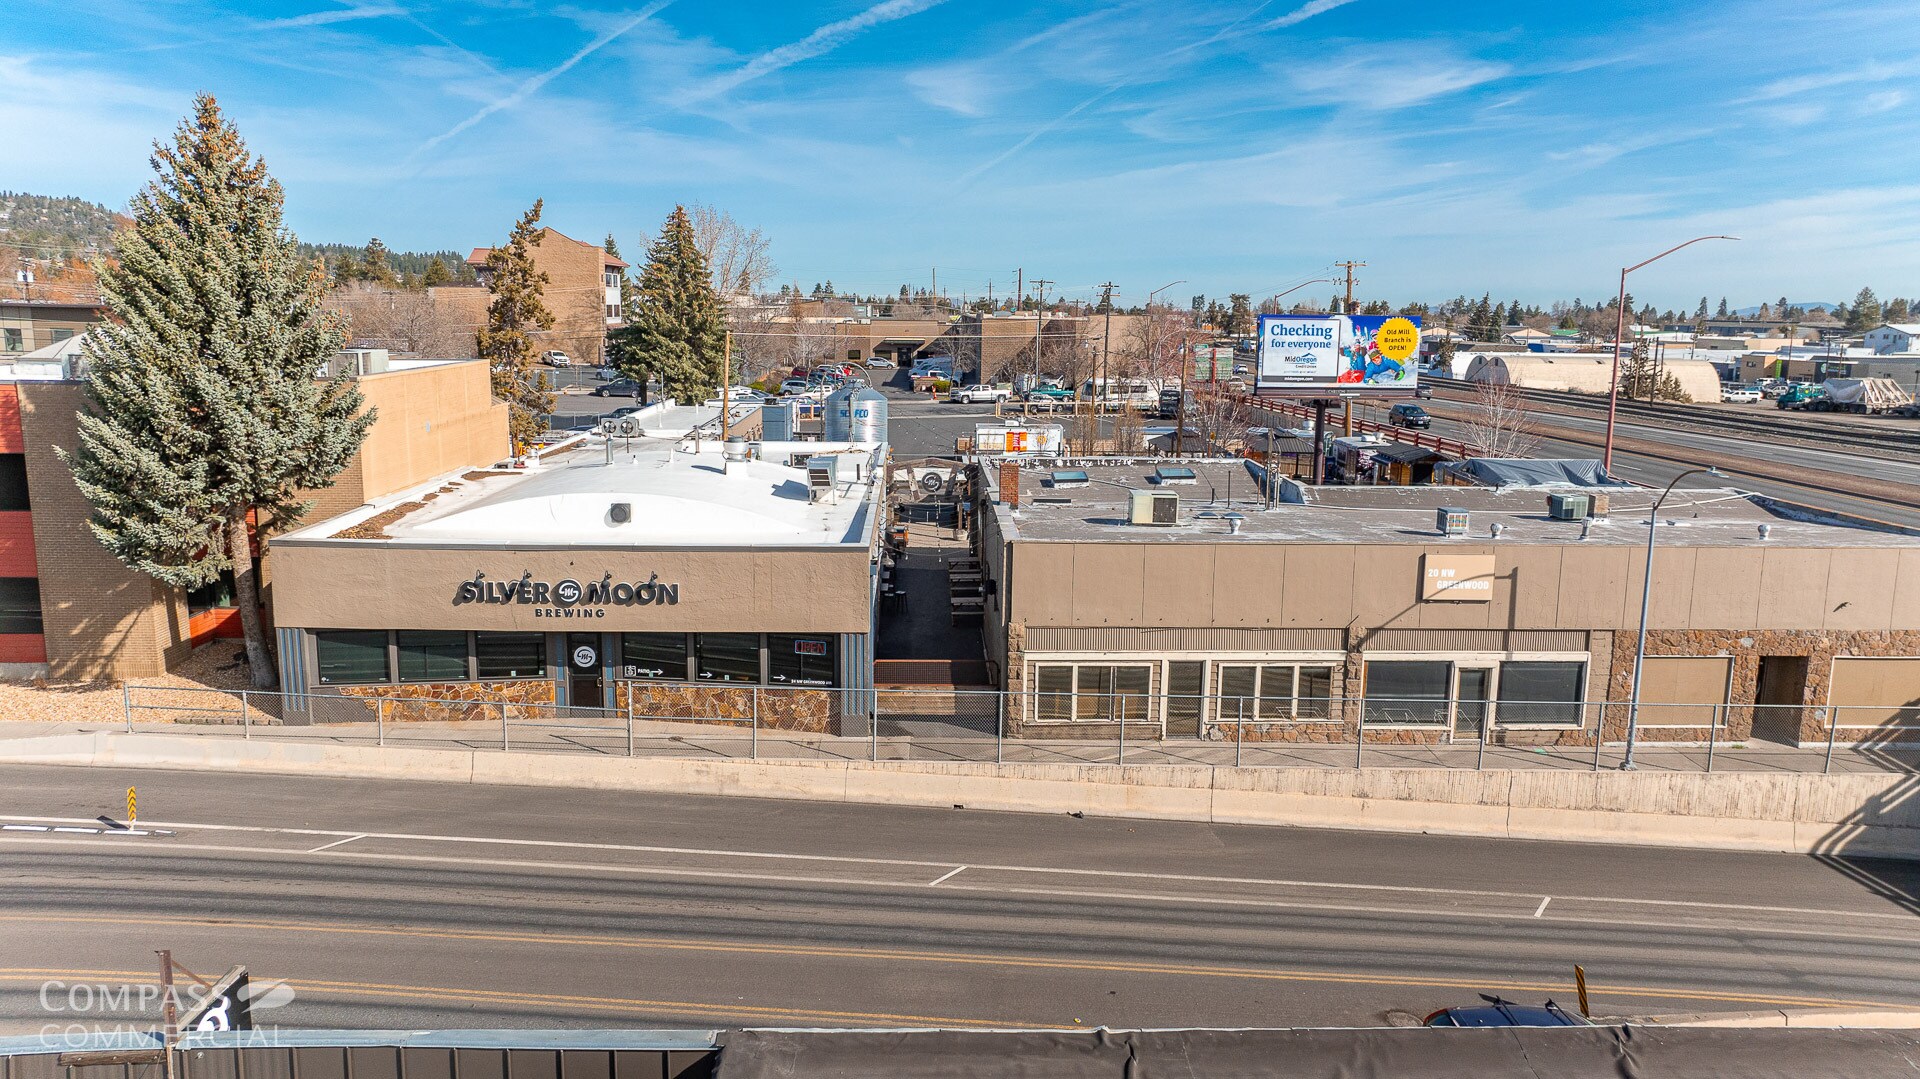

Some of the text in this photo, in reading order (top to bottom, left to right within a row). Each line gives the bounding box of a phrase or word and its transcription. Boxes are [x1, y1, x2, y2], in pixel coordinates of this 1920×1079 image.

[1271, 324, 1332, 341] Checking
[1271, 338, 1331, 350] for everyone
[1428, 568, 1455, 577] 20 NW
[1437, 580, 1489, 590] GREENWOOD
[458, 580, 551, 604] SILVER
[589, 581, 680, 605] MOON
[535, 608, 605, 618] BREWING
[796, 642, 824, 653] OPEN
